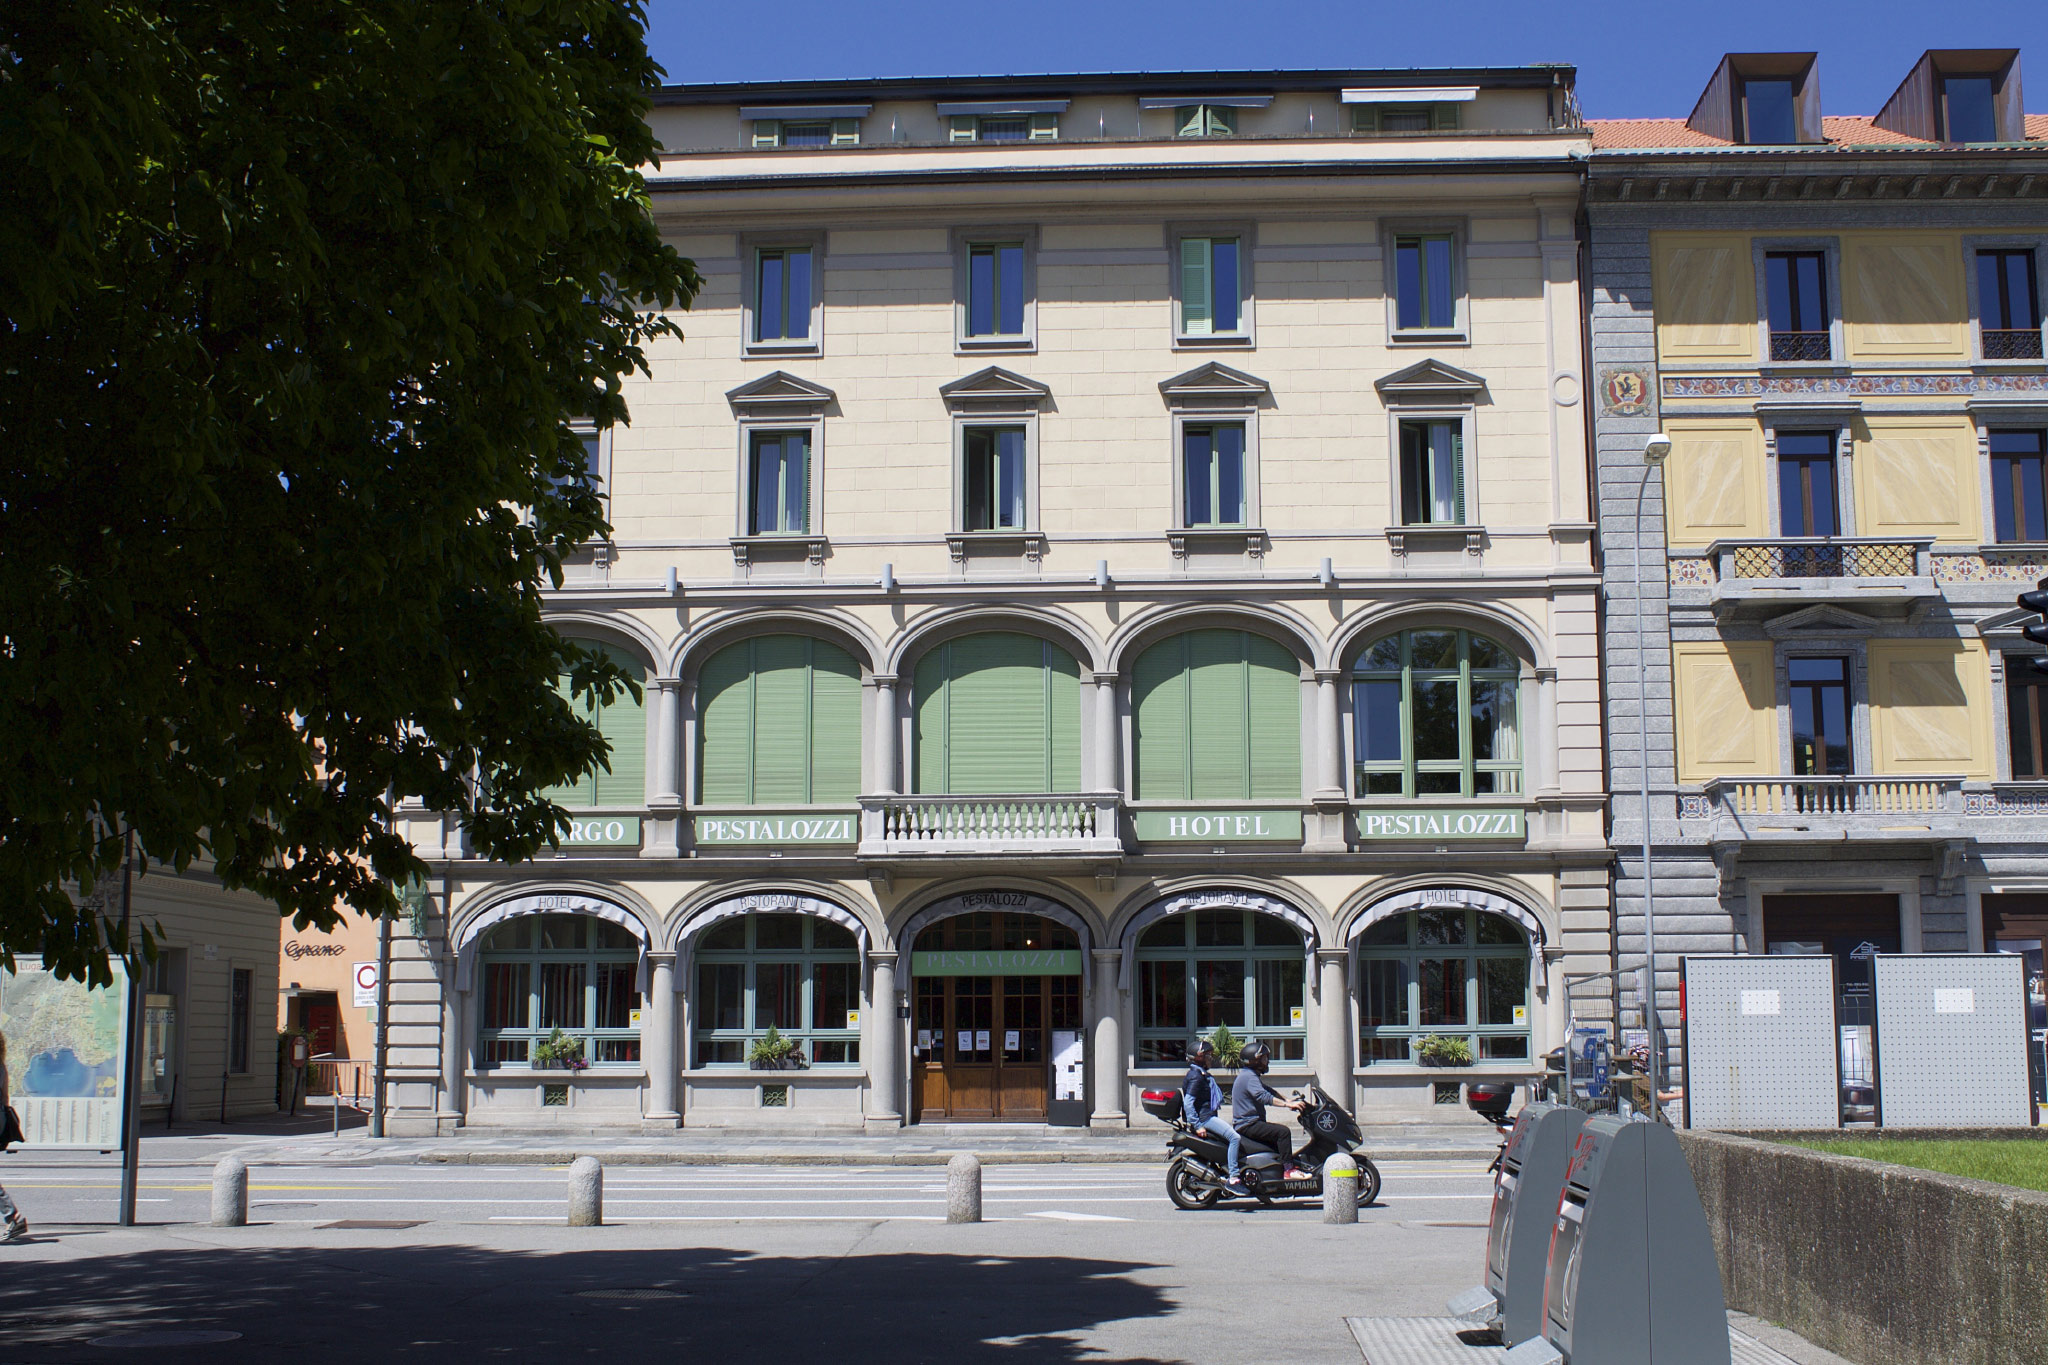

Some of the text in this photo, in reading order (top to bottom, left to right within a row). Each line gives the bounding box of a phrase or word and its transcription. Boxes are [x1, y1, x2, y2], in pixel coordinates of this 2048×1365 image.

[555, 821, 624, 842] ERGO
[702, 819, 850, 841] PESTALOZZI
[1169, 816, 1270, 836] HOTEL
[1366, 814, 1518, 835] PESTALOZZI
[538, 896, 571, 909] HOTEL
[740, 895, 807, 909] RISTORANTE
[962, 893, 1028, 908] PESTALOZZI
[1184, 891, 1250, 905] RISTORANTE
[1426, 890, 1462, 902] HOTEL
[20, 962, 42, 972] Luga
[926, 952, 1066, 968] PESTALOZZI
[1284, 1180, 1318, 1190] YAMAHA
